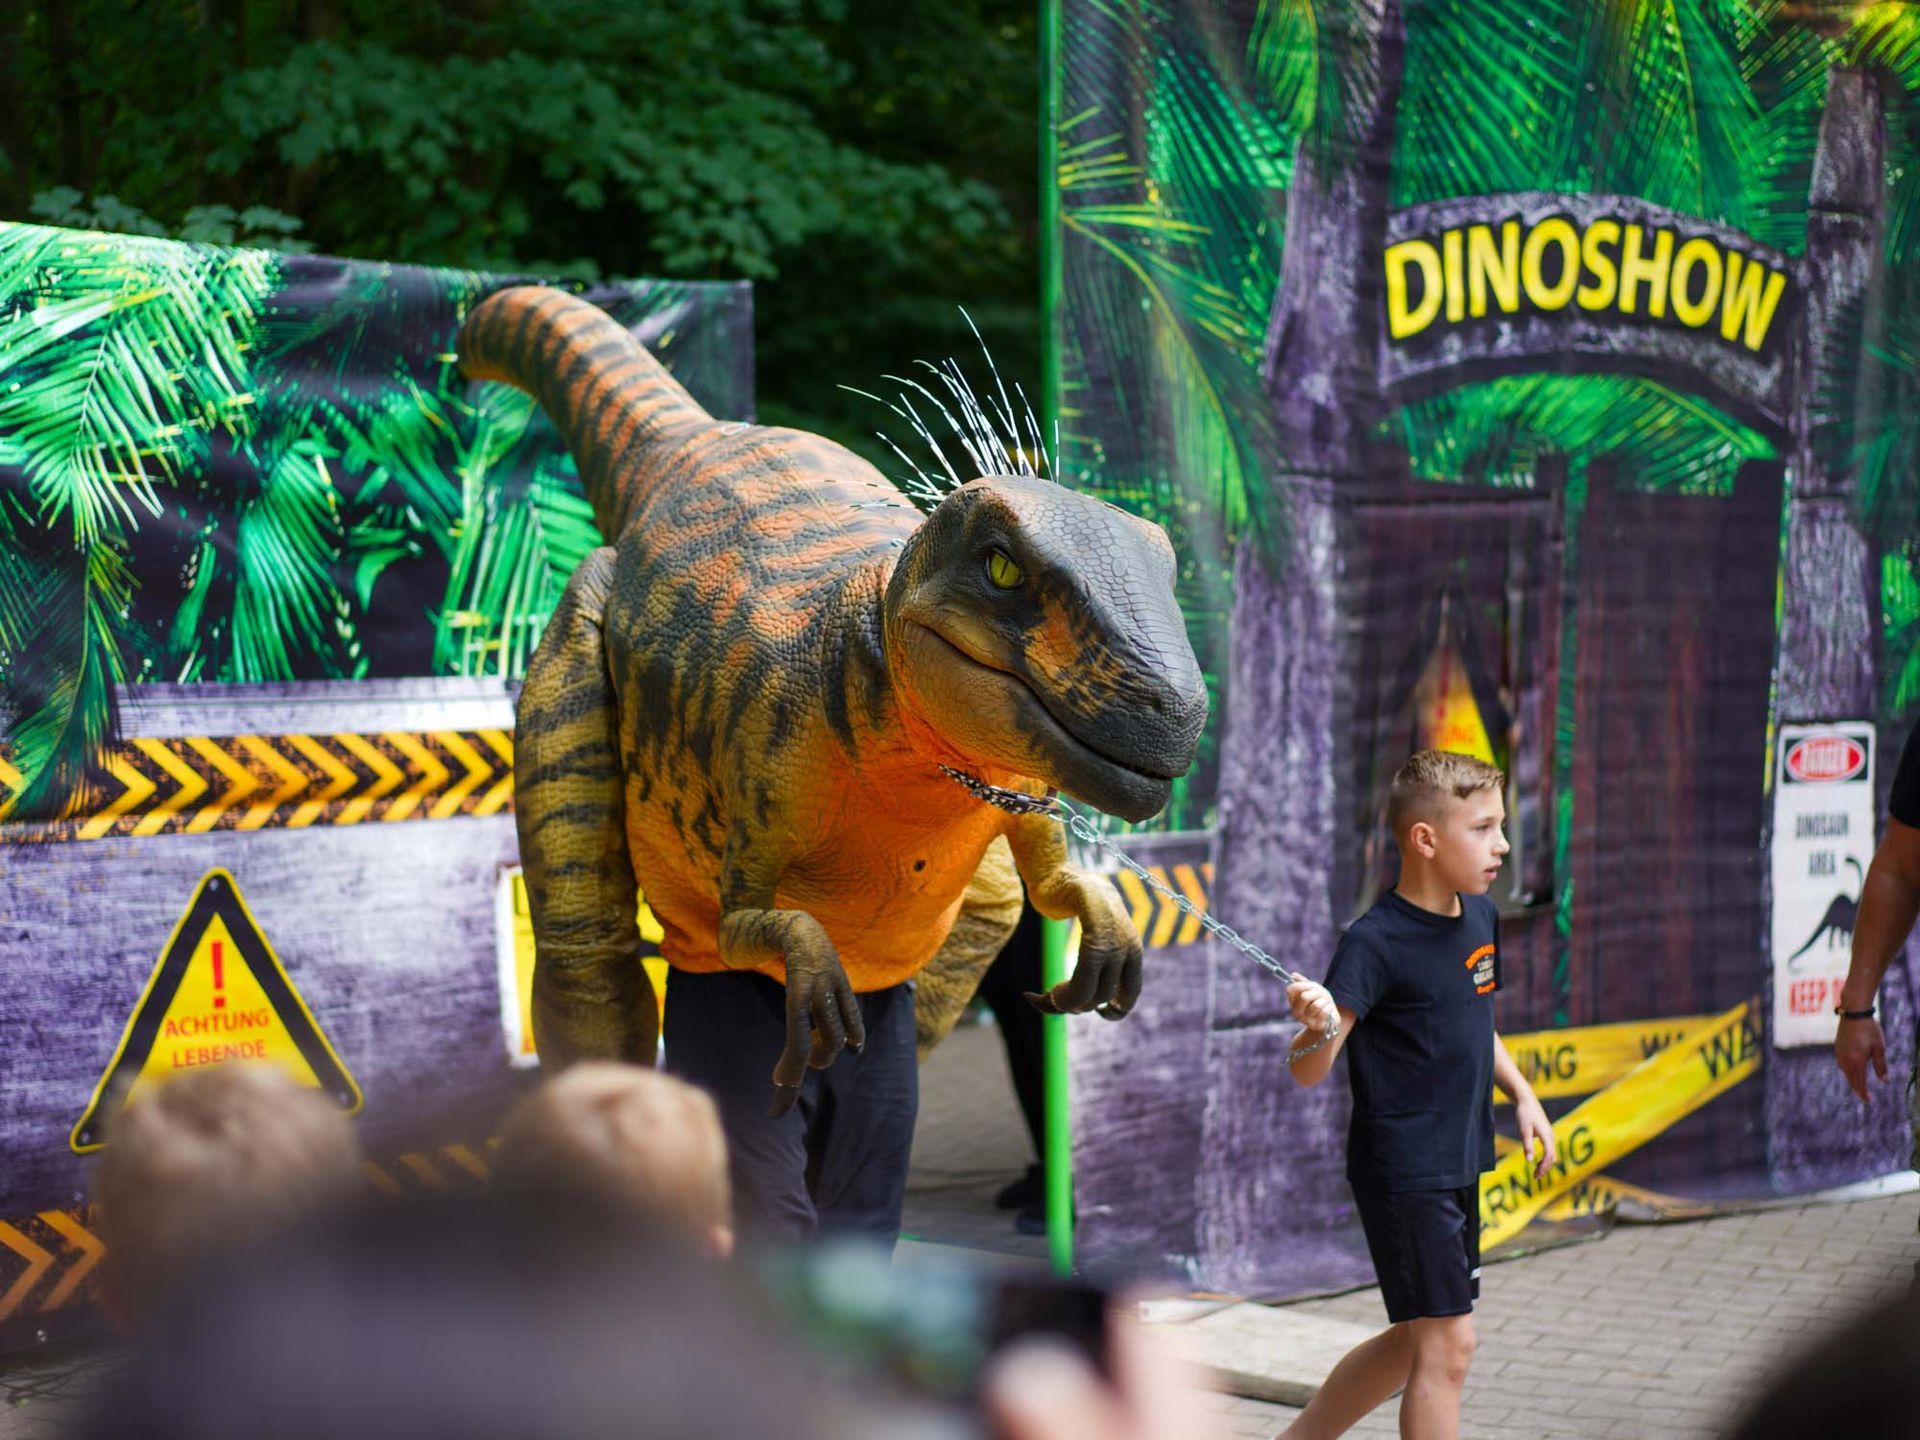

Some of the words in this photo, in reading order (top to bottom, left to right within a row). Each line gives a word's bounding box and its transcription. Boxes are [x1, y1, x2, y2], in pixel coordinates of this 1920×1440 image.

[1384, 217, 1786, 352] DINOSHOW
[1795, 812, 1849, 840] DINOSAUR
[1808, 850, 1836, 876] AREA
[1788, 978, 1827, 1015] KEEP
[164, 1008, 270, 1038] ACHTUNG
[172, 1039, 268, 1069] LEBENDE
